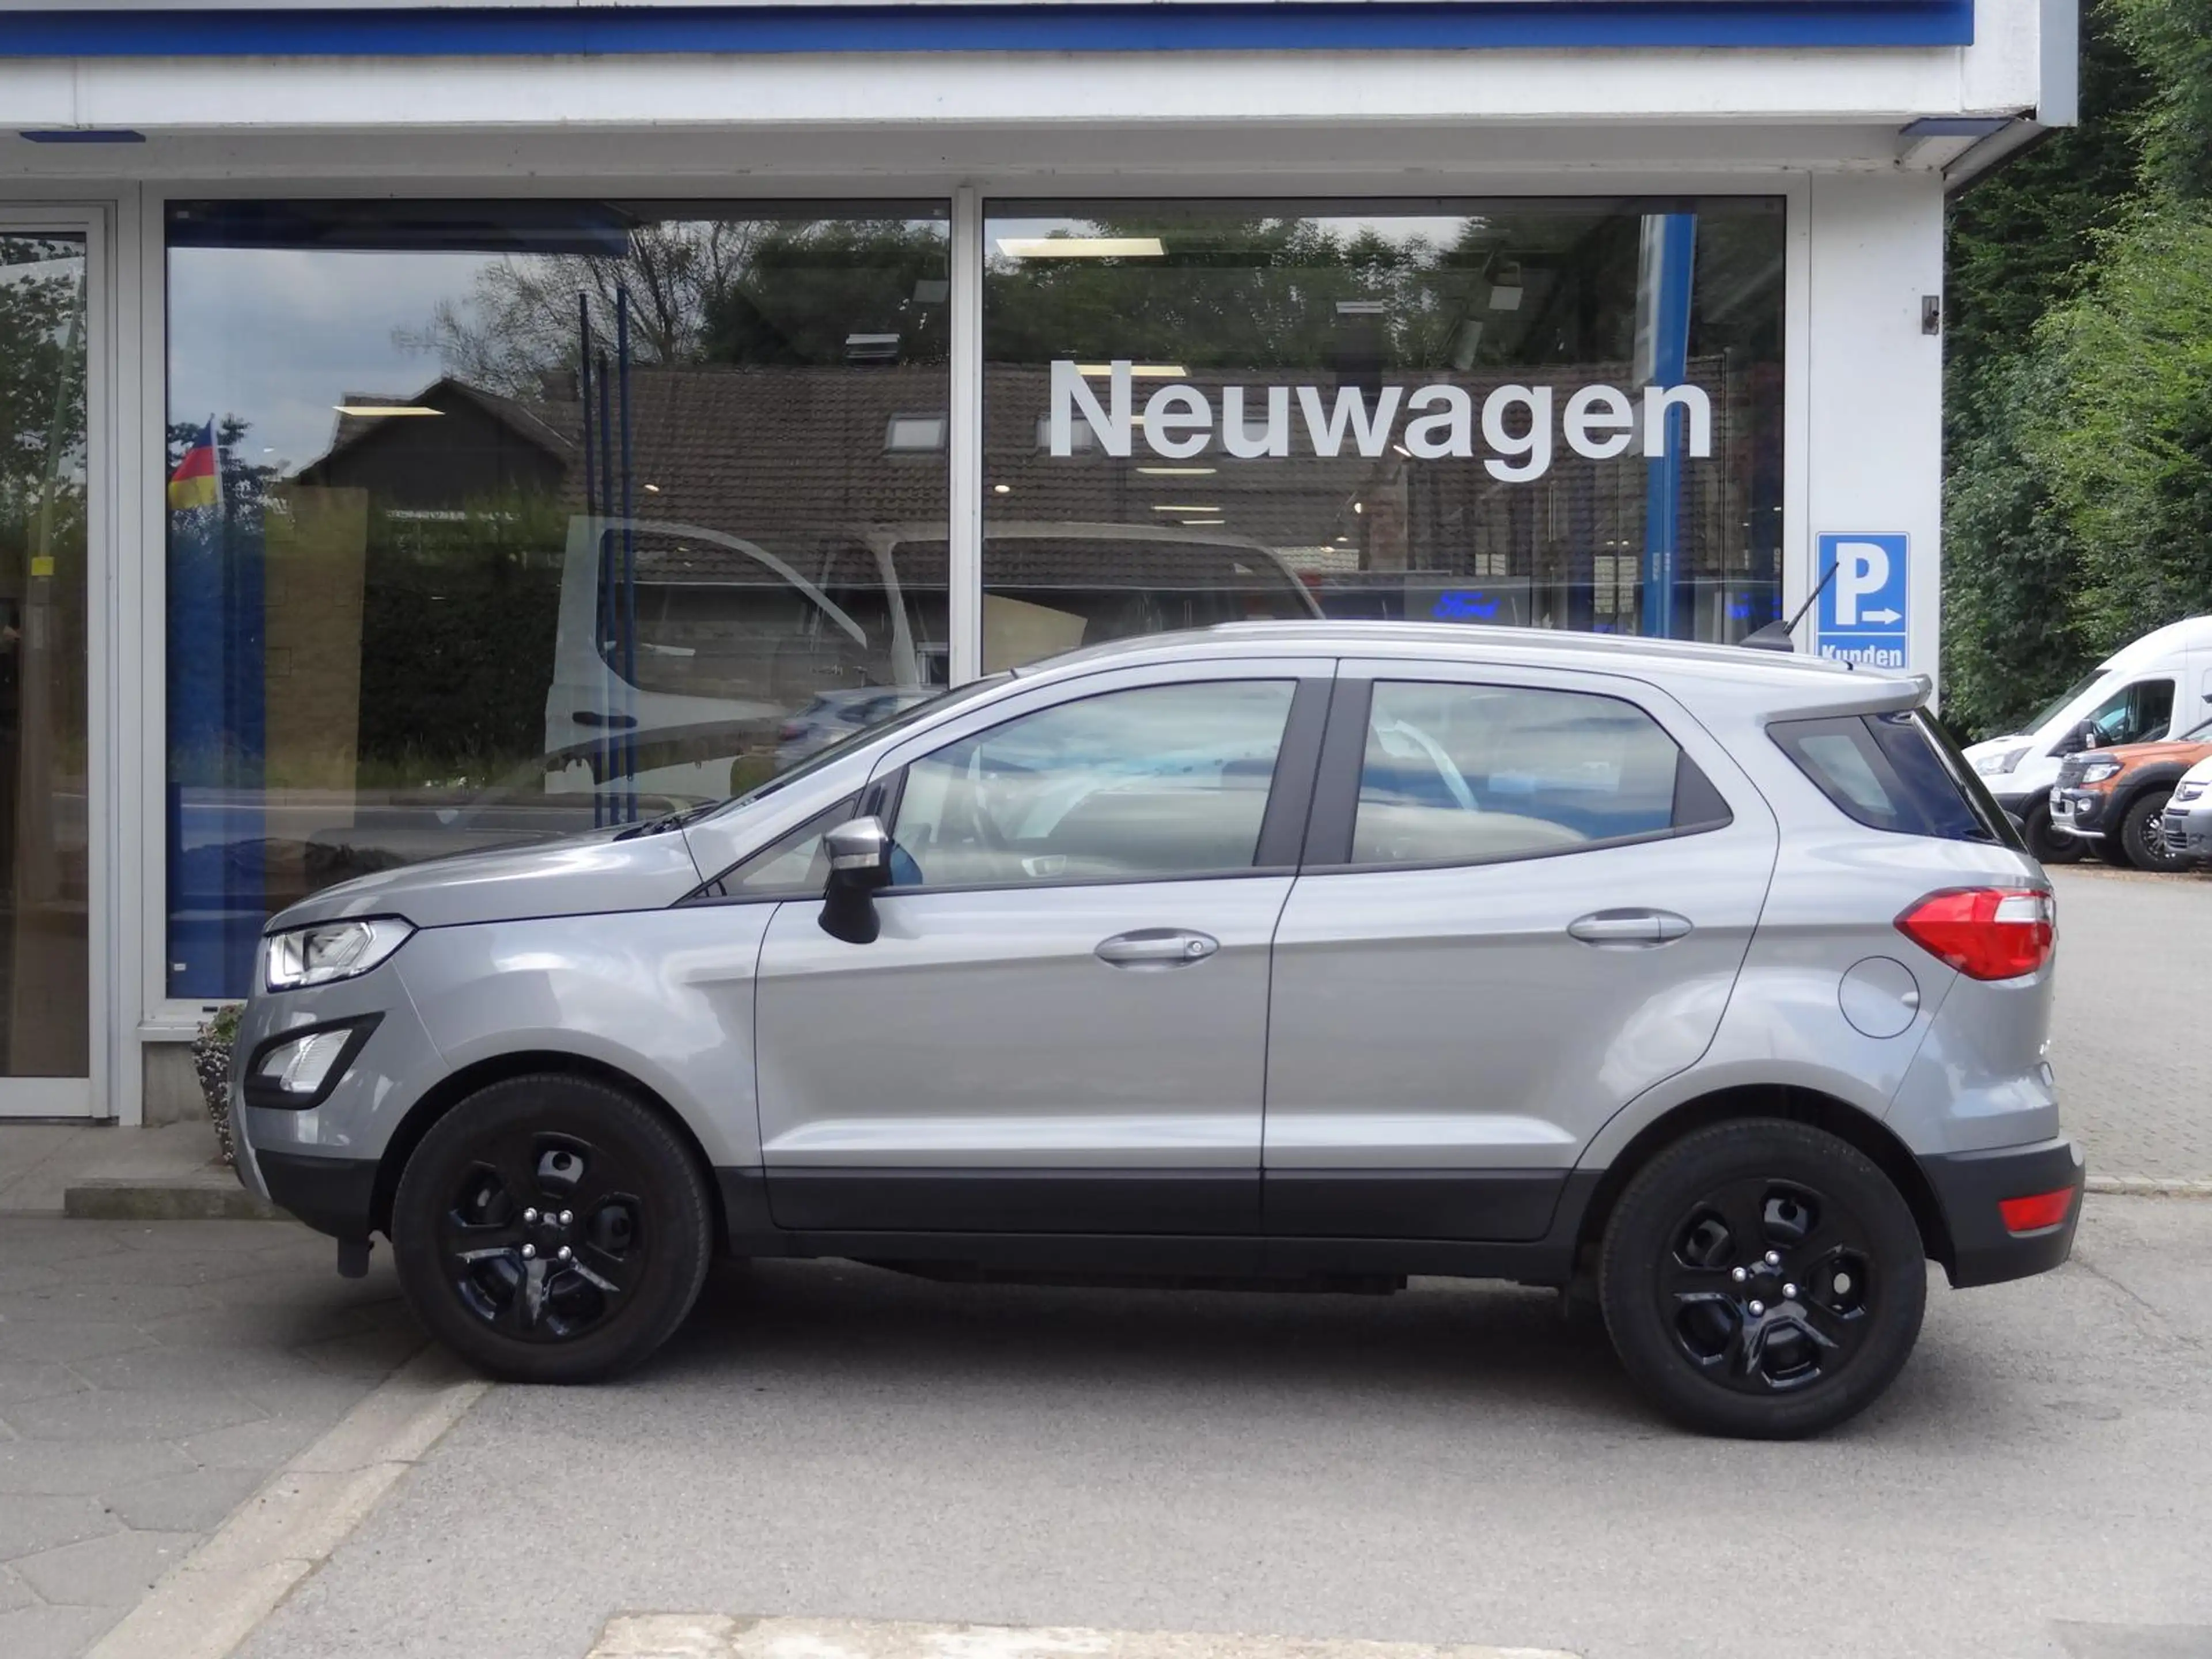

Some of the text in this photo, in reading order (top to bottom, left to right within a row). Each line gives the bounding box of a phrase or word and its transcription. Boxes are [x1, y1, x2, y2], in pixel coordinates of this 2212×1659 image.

[1050, 360, 1711, 483] Neuwagen
[1836, 543, 1889, 624] P
[1822, 644, 1902, 666] Kunden
